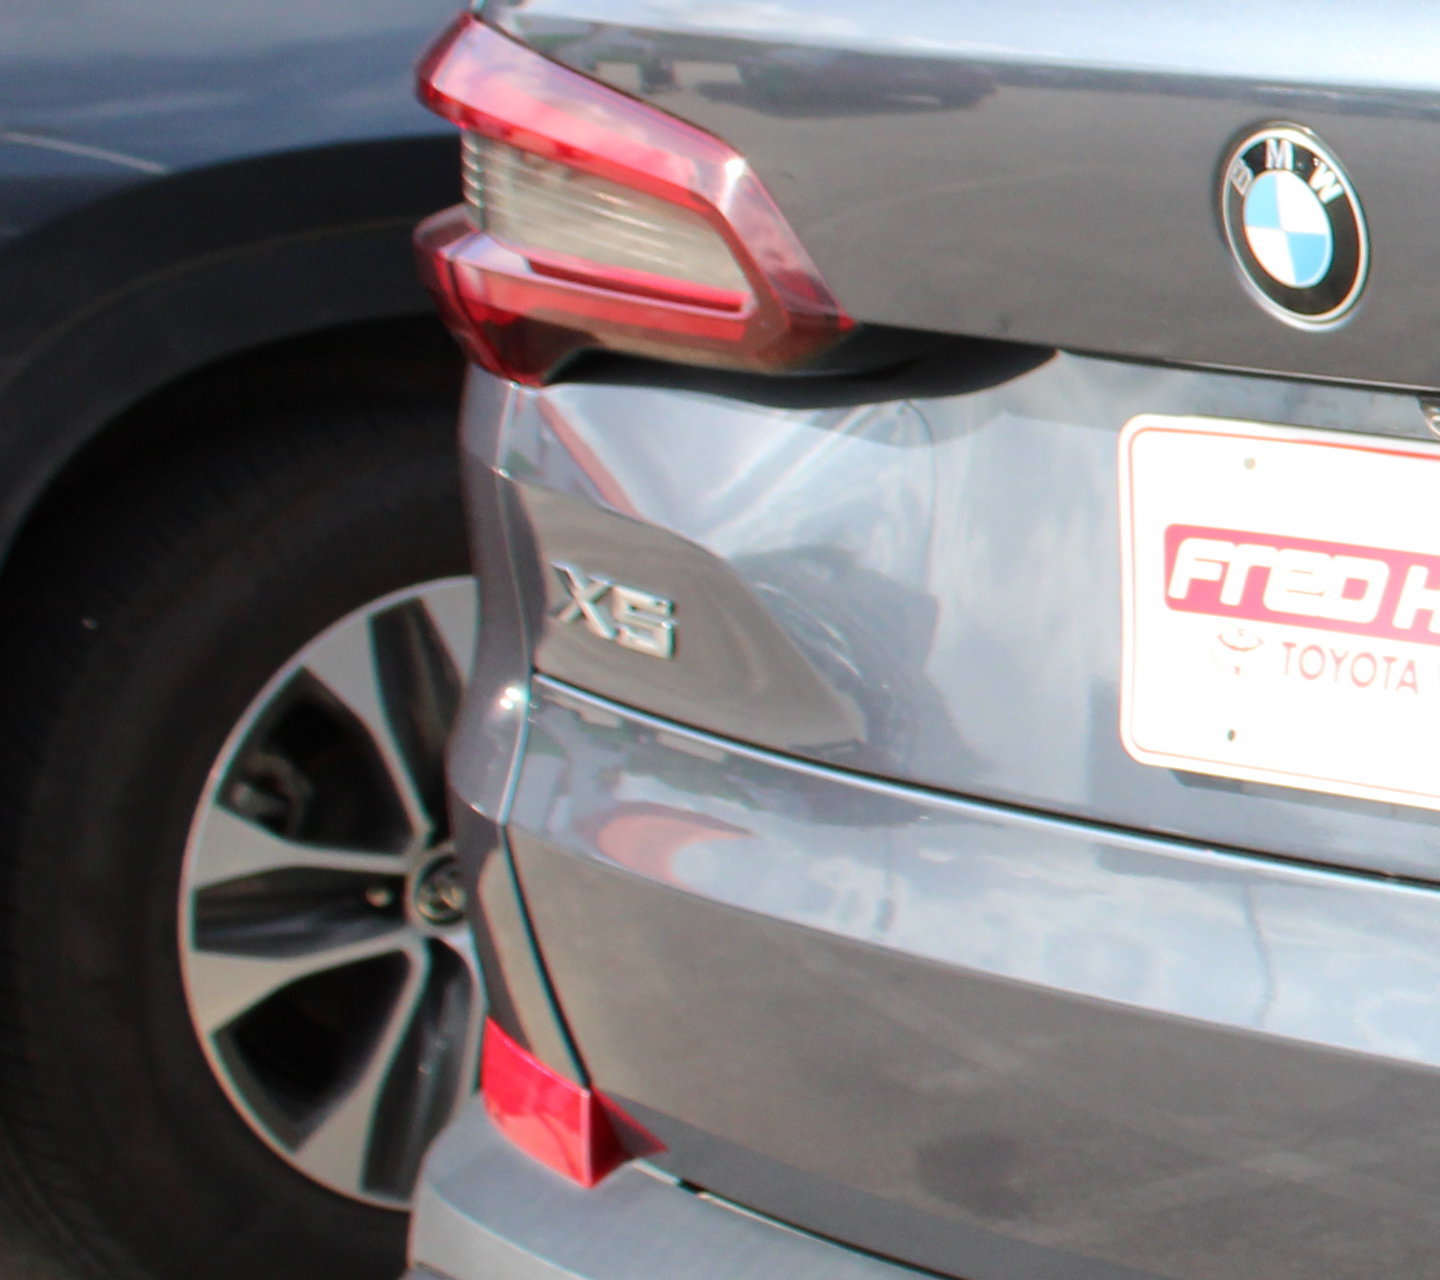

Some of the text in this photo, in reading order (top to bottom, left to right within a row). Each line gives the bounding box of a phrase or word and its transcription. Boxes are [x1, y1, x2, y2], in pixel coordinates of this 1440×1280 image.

[1229, 138, 1345, 204] BMW
[550, 561, 676, 660] X5
[1281, 640, 1419, 696] TOYOTA
